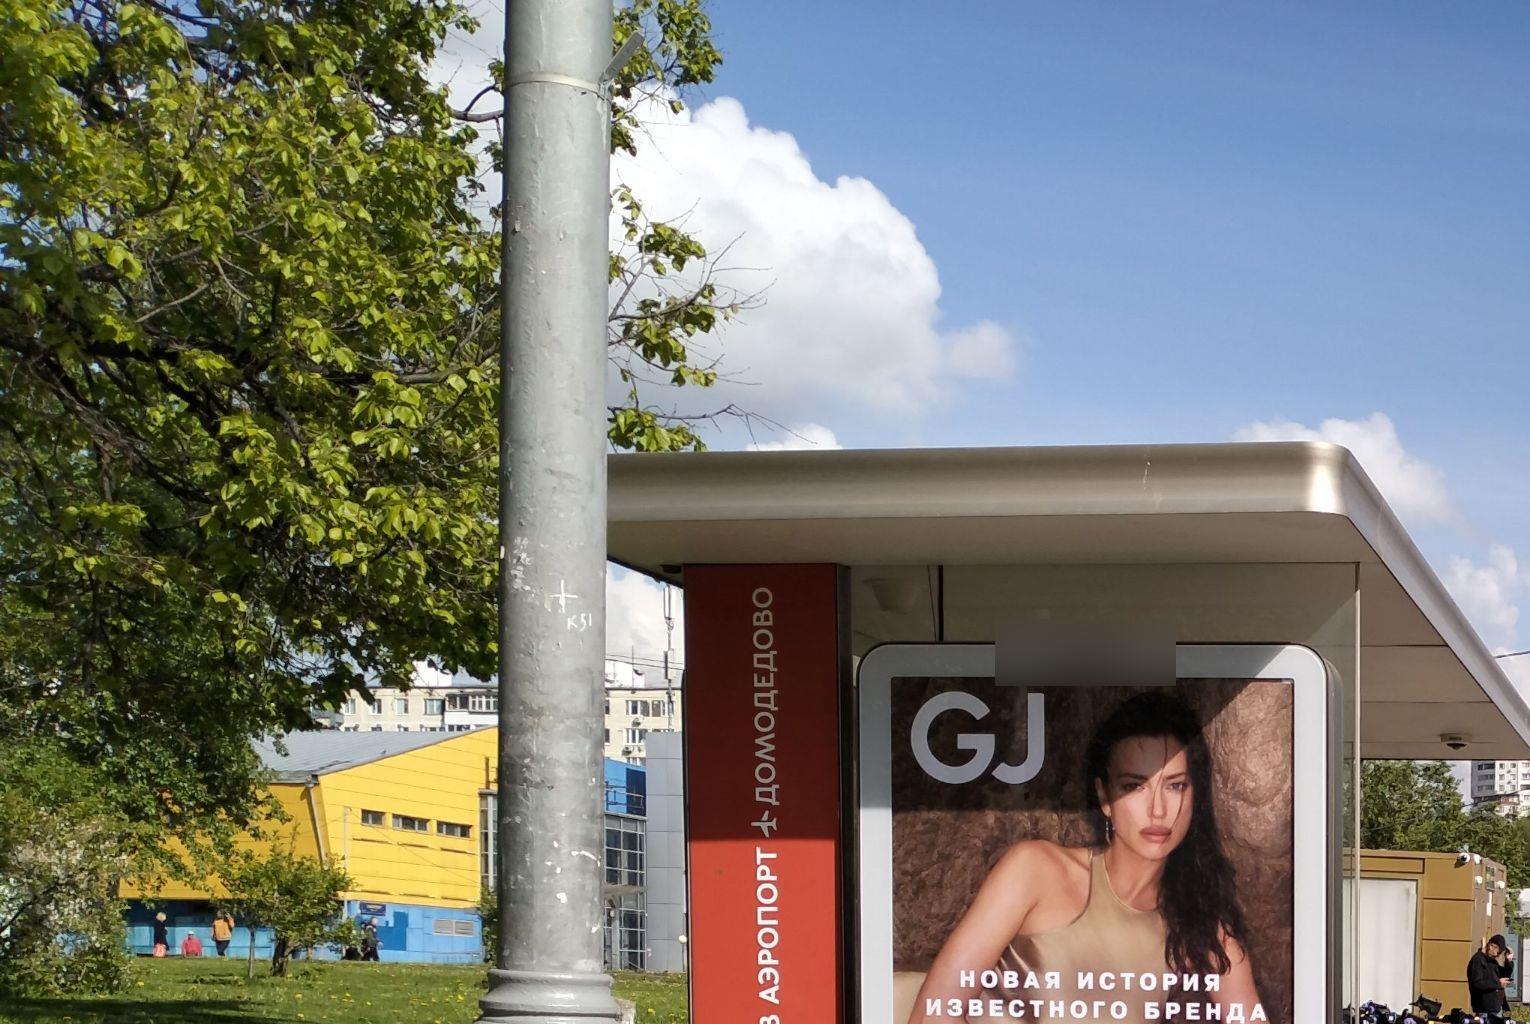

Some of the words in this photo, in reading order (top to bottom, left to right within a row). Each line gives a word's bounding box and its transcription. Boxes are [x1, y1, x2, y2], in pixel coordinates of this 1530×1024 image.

[752, 586, 780, 805] ДОМОДЕДОВО
[911, 691, 1045, 784] GJ
[756, 846, 781, 1005] АЭРОПОРТ
[925, 998, 1128, 1019] ИЗВЕСТНОГО
[1144, 1001, 1268, 1024] БРЕНДА
[959, 970, 1062, 989] НОВАЯ
[1077, 971, 1221, 992] ИСТОРИЯ
